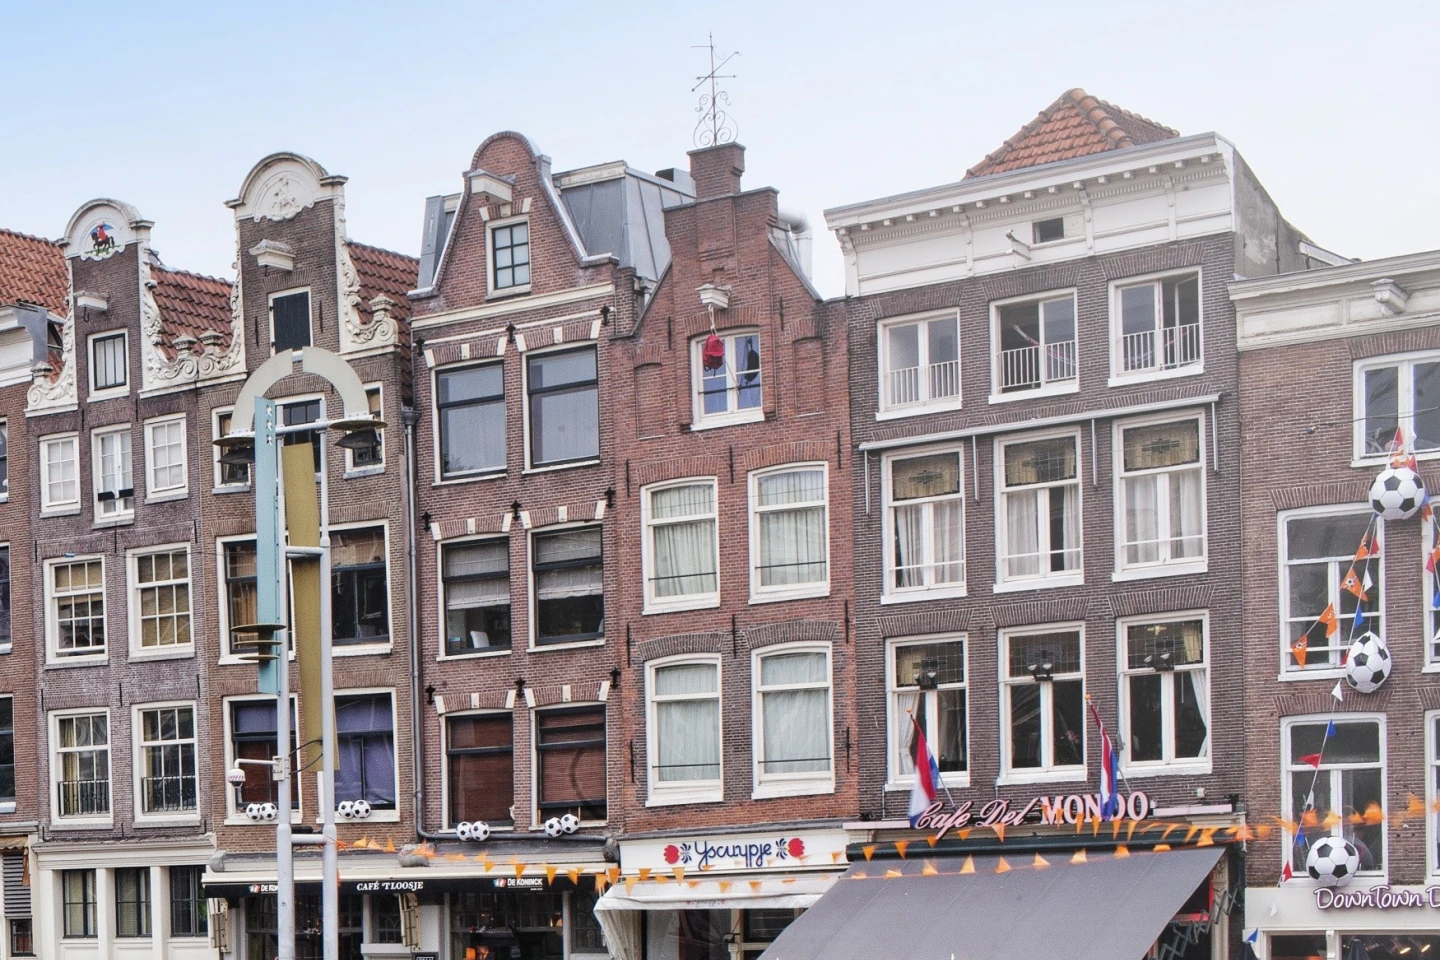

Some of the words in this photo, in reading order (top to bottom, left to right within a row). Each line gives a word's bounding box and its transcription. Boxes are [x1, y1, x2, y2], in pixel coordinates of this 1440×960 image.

[915, 801, 972, 840] Cafe
[975, 797, 1039, 827] Del
[1040, 791, 1150, 825] MONDO
[356, 881, 380, 891] CAFÉ
[1313, 885, 1423, 909] DownTown
